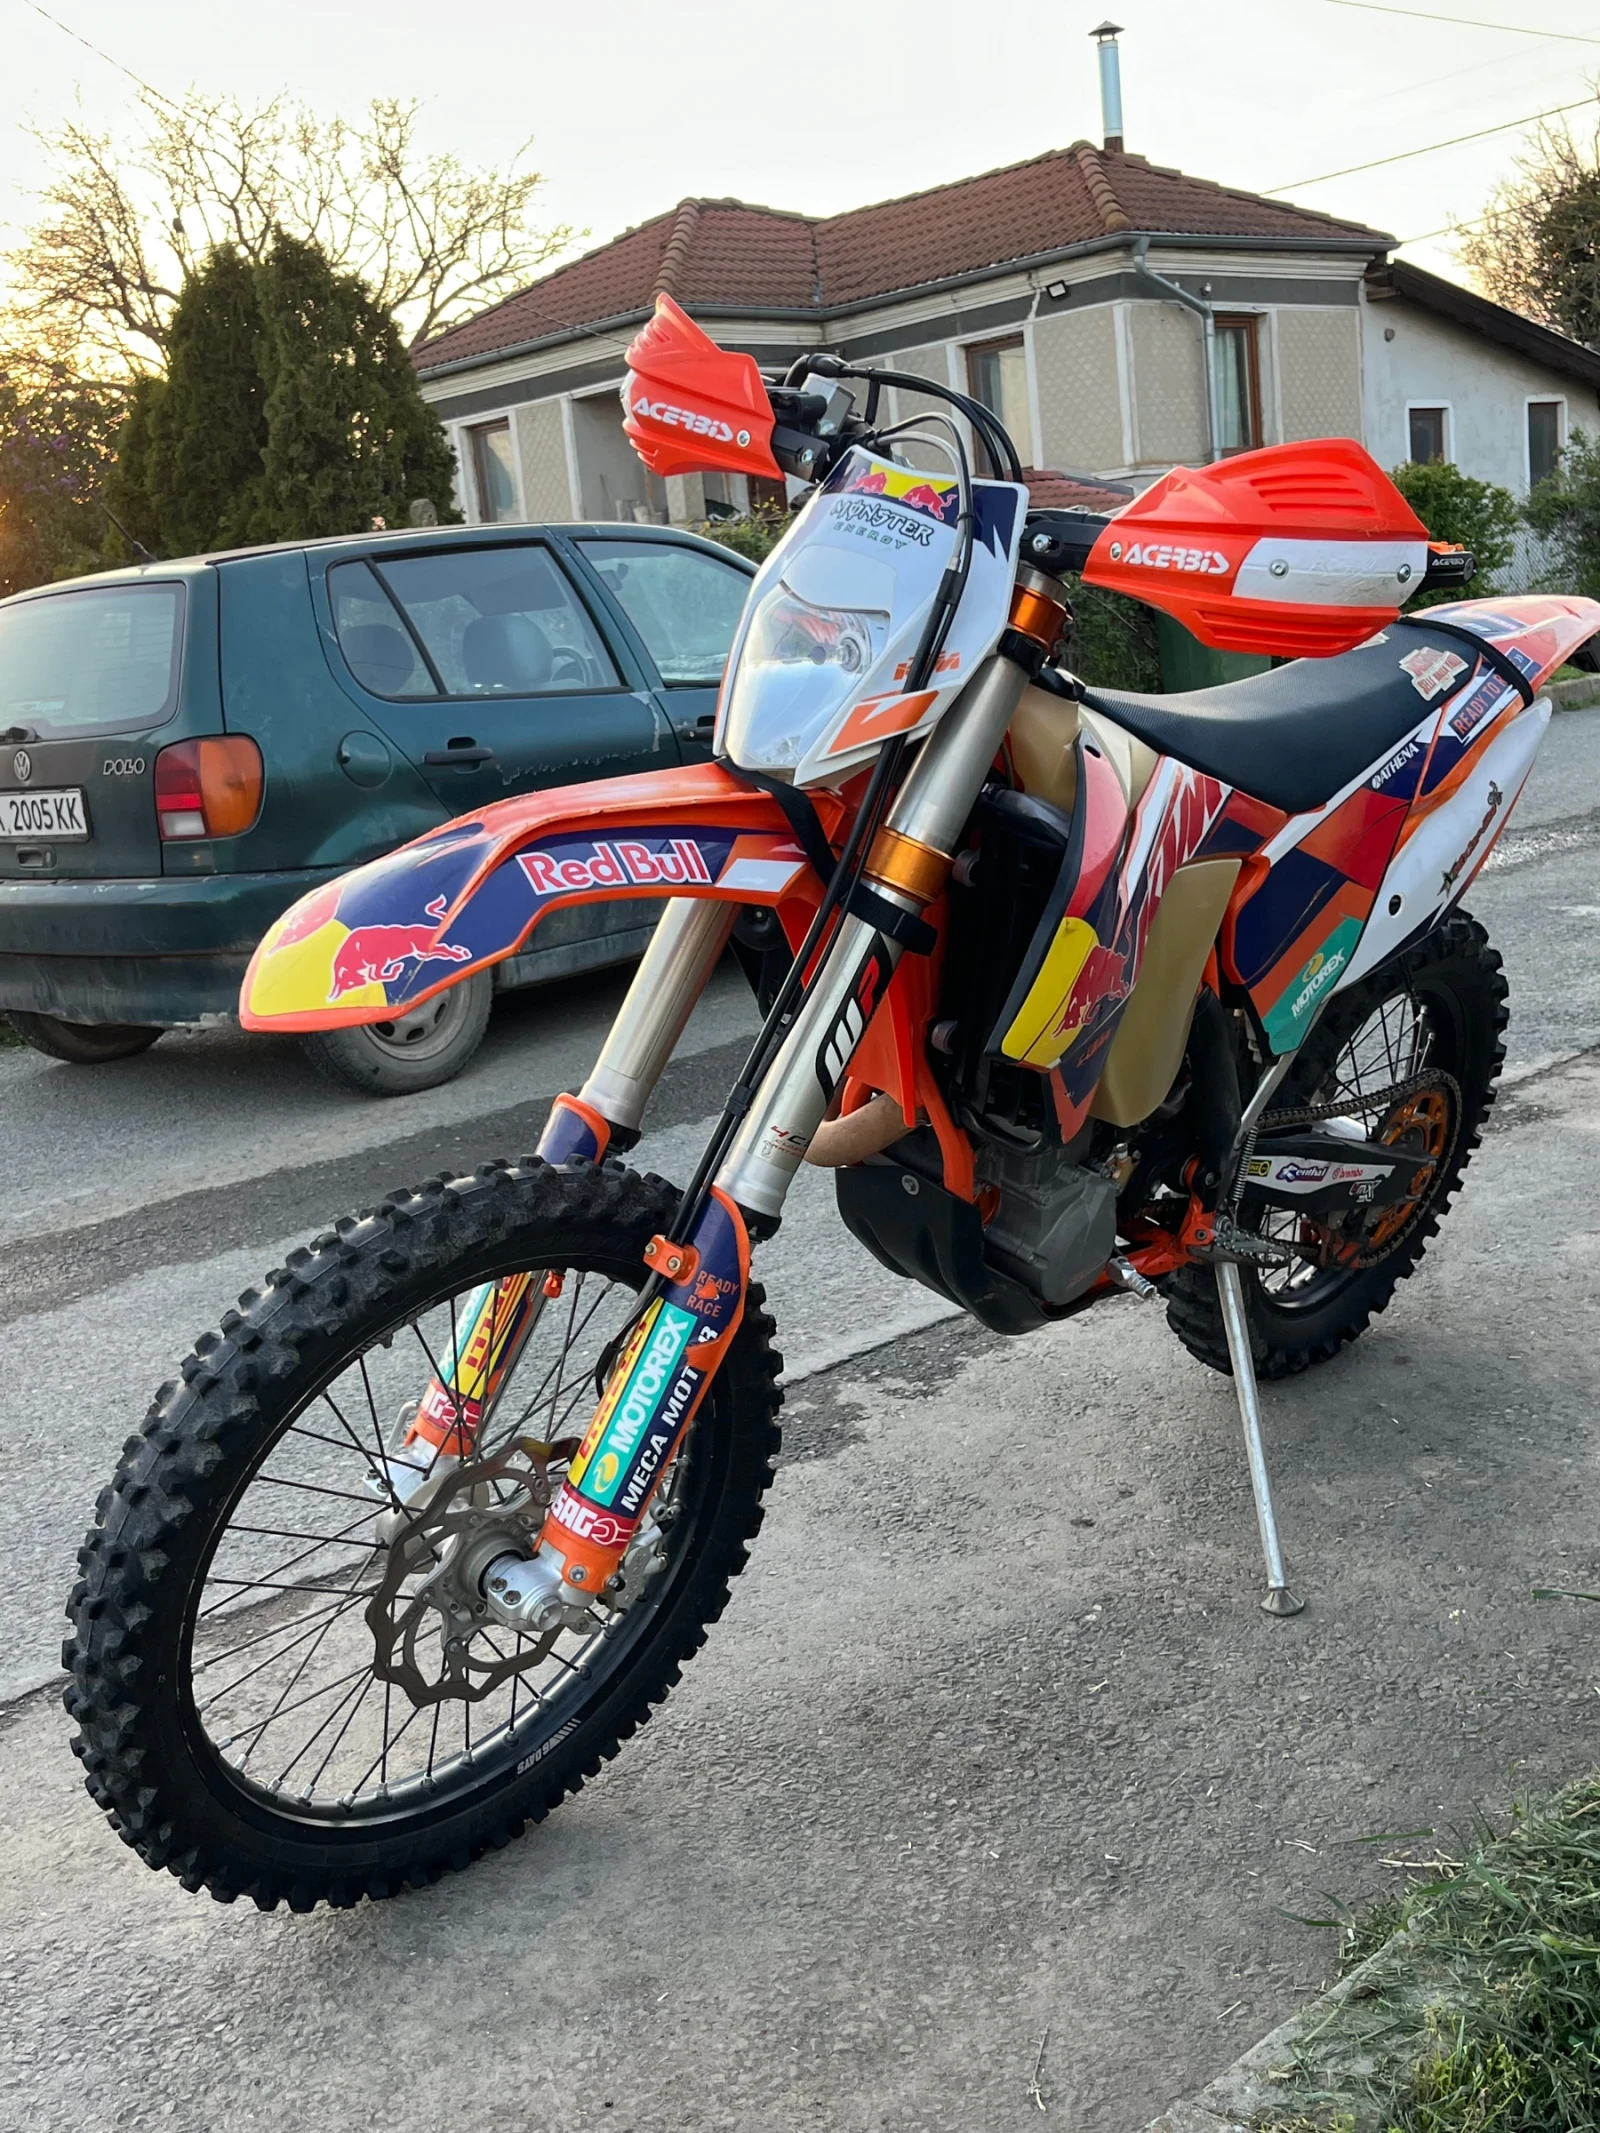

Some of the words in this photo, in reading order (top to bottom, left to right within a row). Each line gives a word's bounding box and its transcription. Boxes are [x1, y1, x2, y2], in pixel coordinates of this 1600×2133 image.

[632, 397, 733, 442] ACERBIS
[833, 521, 908, 549] ENERGY
[1123, 543, 1230, 574] ACERBIS
[1453, 699, 1489, 735] READY
[1482, 680, 1502, 699] TO
[103, 757, 146, 775] POLO
[1379, 742, 1420, 784] ATHENA
[516, 842, 627, 894] Red
[615, 840, 711, 883] Bull
[1291, 947, 1345, 1018] MOTOREX
[686, 1295, 722, 1317] RACE
[608, 1312, 690, 1454] MOTOREX
[620, 1434, 669, 1512] MECA
[661, 1325, 719, 1428] MOTR
[517, 1747, 542, 1775] DAYS
